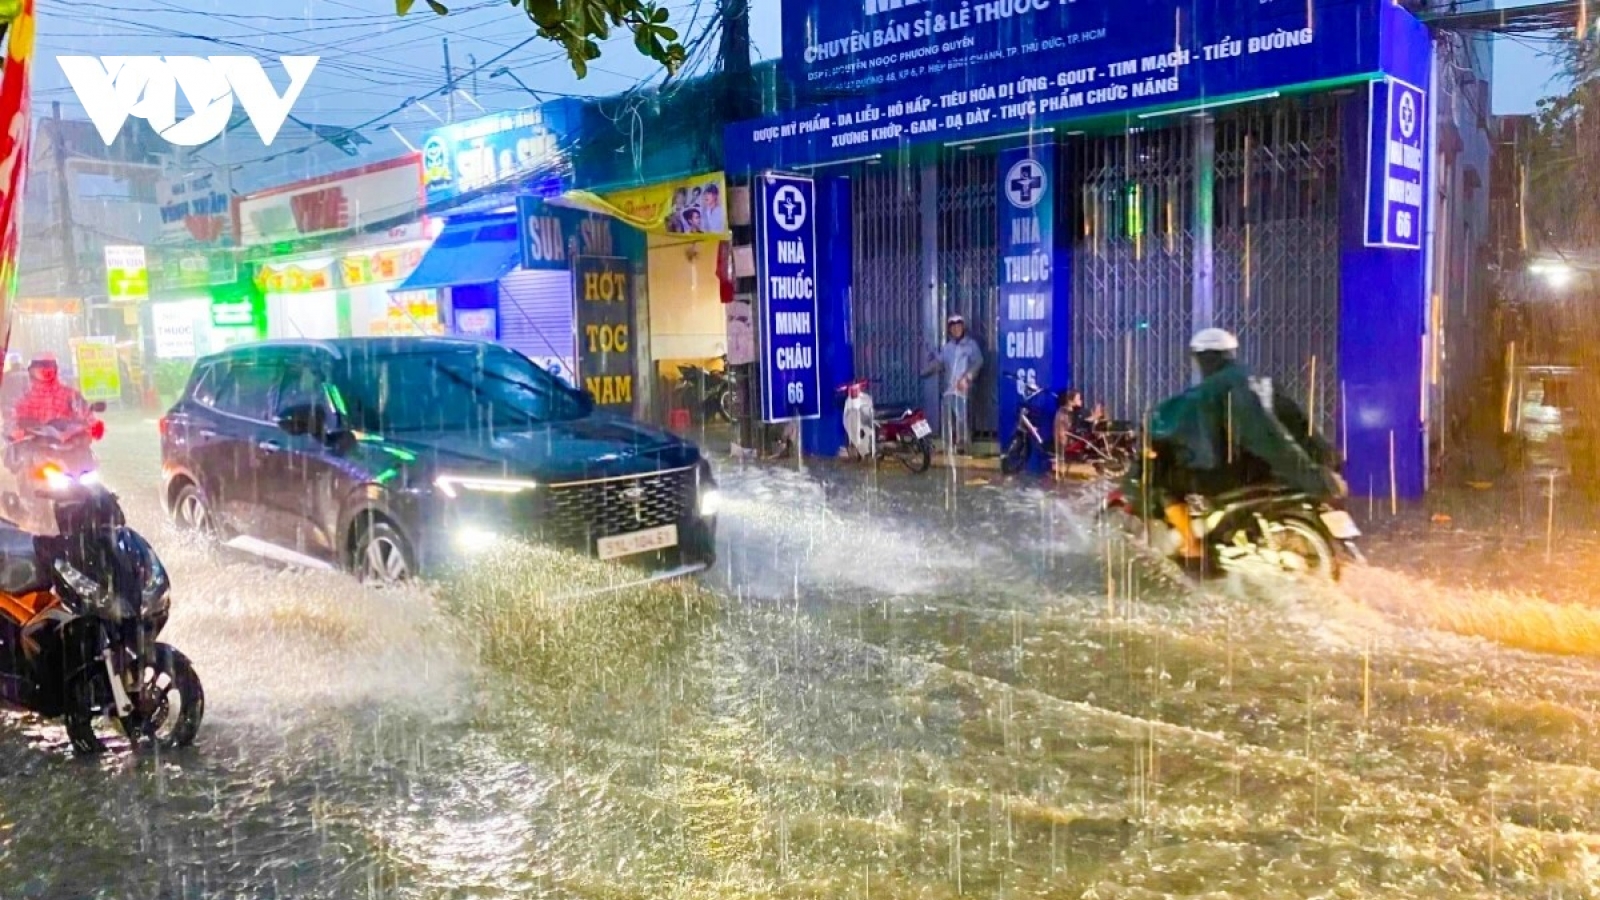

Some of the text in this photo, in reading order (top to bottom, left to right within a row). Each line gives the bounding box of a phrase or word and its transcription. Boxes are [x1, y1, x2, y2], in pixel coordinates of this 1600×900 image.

[804, 29, 870, 63] CHUYÊN
[873, 19, 910, 47] BÁN
[913, 10, 932, 38] SỈ
[933, 14, 948, 32] &
[950, 1, 971, 29] LẺ
[1082, 28, 1106, 41] HCM
[869, 54, 898, 67] NGỌC
[900, 44, 939, 61] PHƯƠNG
[781, 121, 797, 137] MỸ
[799, 113, 830, 134] PHẨM
[838, 113, 853, 126] DA
[887, 100, 903, 118] HÔ
[905, 95, 931, 114] HẤP
[940, 91, 967, 108] TIÊU
[969, 83, 996, 103] HÓA
[1000, 82, 1013, 99] DỊ
[1017, 76, 1048, 94] ỨNG
[1057, 67, 1096, 86] GOUT
[1108, 59, 1137, 78] TIM
[1141, 47, 1189, 72] MẠCH
[1203, 36, 1241, 61] TIỂU
[1248, 27, 1312, 54] ĐƯỜNG
[831, 131, 868, 148] XƯƠNG
[871, 122, 901, 140] KHỚP
[911, 118, 936, 134] GAN
[946, 114, 963, 130] DẠ
[966, 107, 991, 125] DÀY
[1001, 102, 1036, 119] THỰC
[1040, 88, 1083, 113] PHẨM
[1087, 82, 1128, 104] CHỨC
[1132, 77, 1178, 98] NĂNG
[1011, 215, 1040, 245] NHÀ
[1395, 210, 1411, 238] 66
[777, 237, 805, 264] NHÀ
[1004, 249, 1049, 283] THUỐC
[771, 269, 813, 299] THUỐC
[1008, 294, 1045, 320] MINH
[775, 312, 811, 334] MINH
[776, 343, 812, 370] CHÂU
[1006, 327, 1044, 359] CHÂU
[586, 375, 632, 404] NAM
[787, 382, 804, 404] 66
